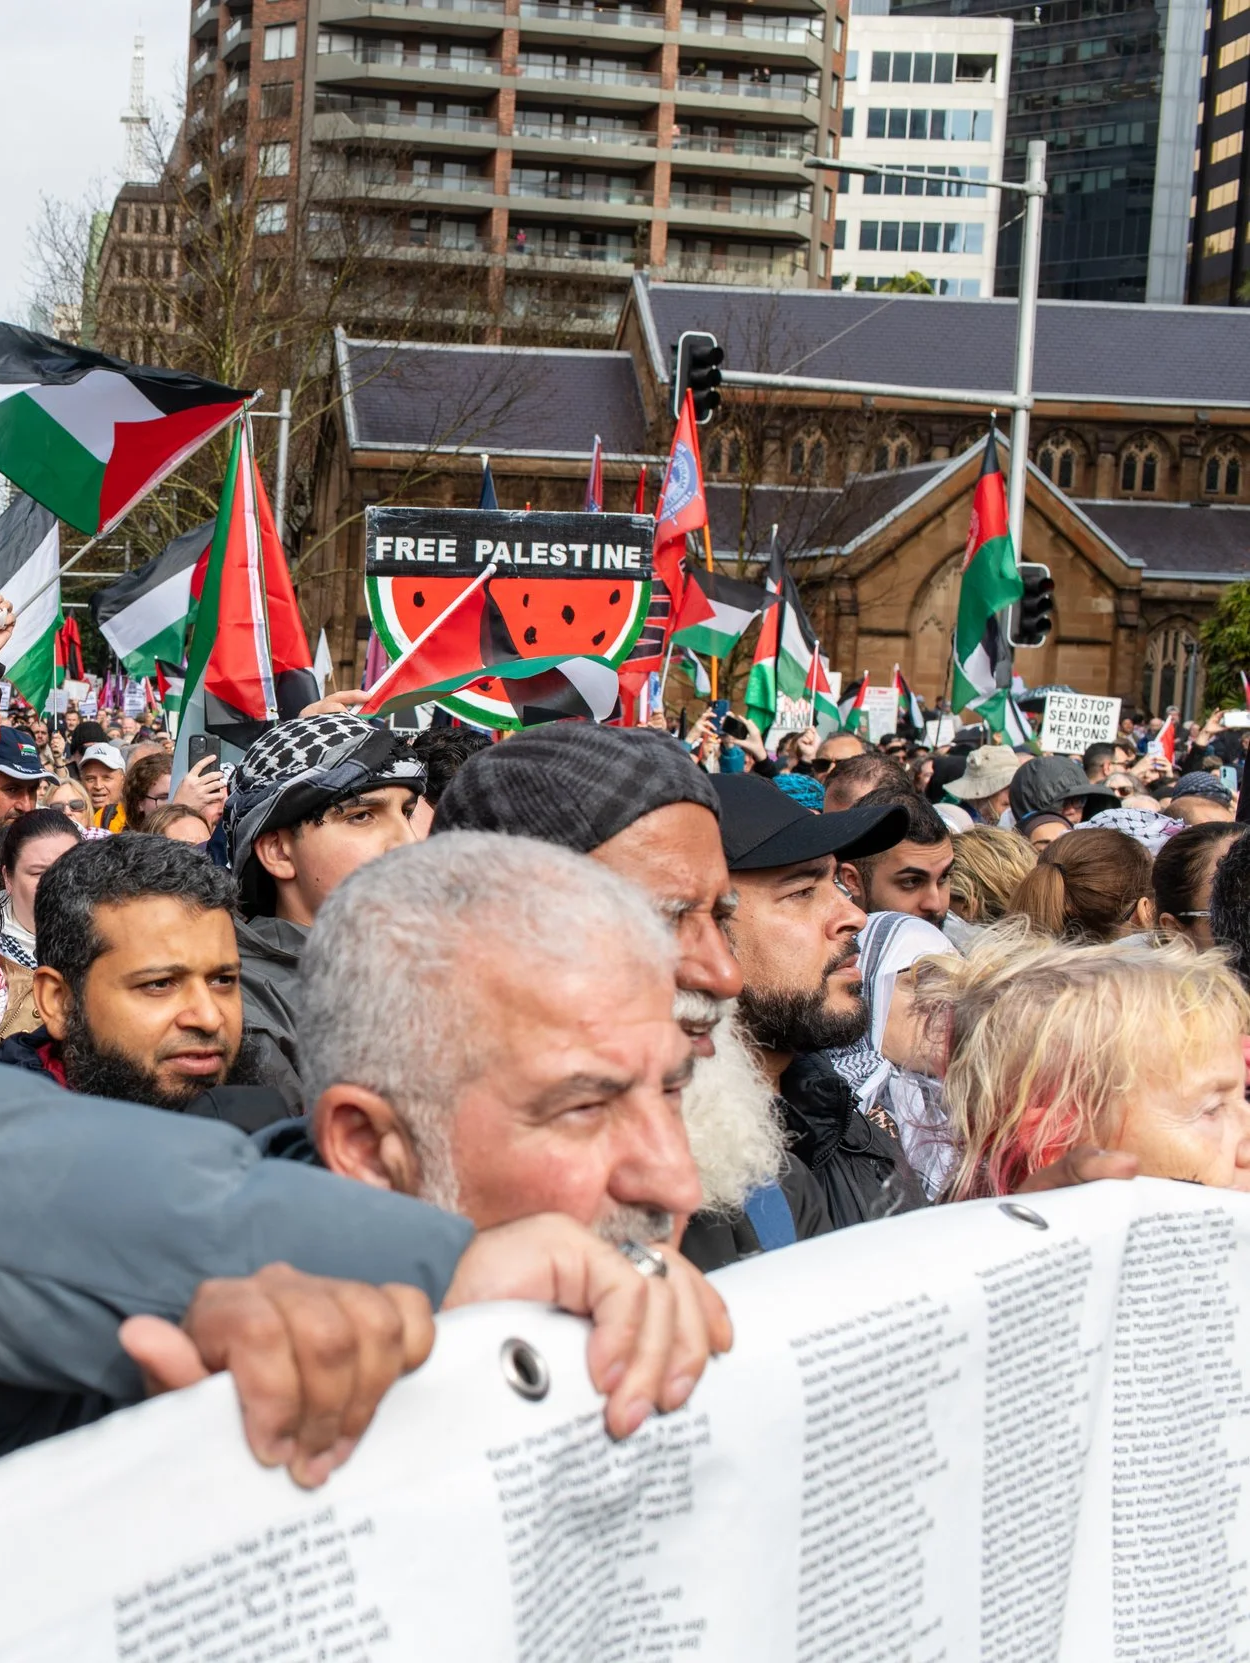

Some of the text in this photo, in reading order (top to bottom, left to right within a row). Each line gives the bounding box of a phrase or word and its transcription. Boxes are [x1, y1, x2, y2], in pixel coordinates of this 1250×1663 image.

[375, 536, 642, 569] FREE PALESTINE
[1049, 695, 1115, 712] FFS! STOP
[1049, 709, 1111, 726] SENDING
[1049, 725, 1109, 741] WEAPONS
[1056, 737, 1090, 751] PART
